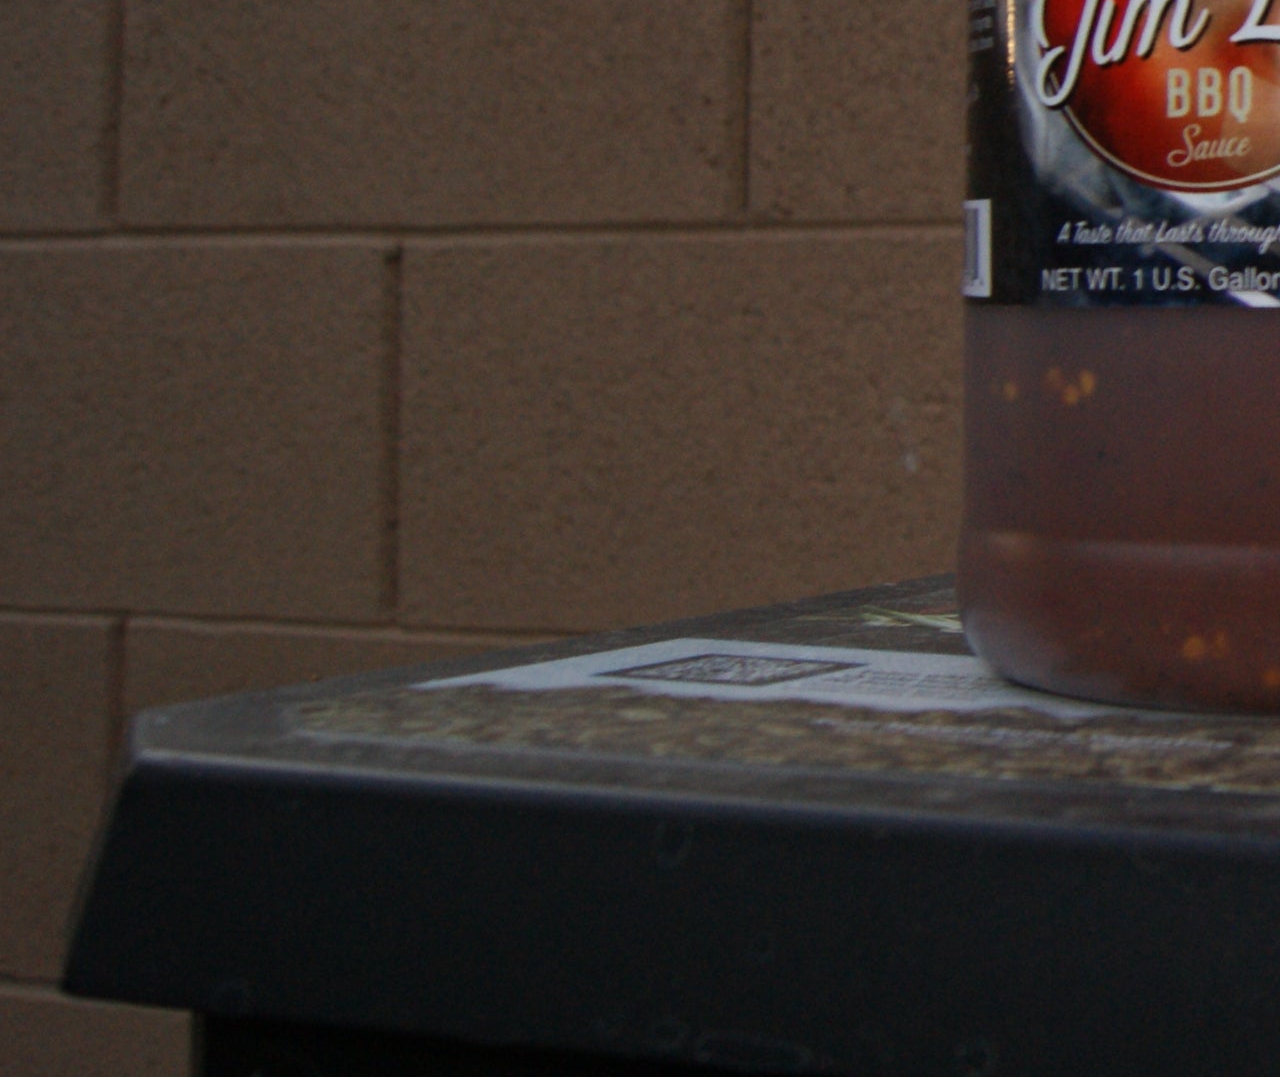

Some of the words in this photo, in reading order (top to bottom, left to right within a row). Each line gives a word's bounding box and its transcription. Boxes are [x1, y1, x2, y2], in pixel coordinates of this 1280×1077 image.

[1166, 66, 1253, 123] BBQ
[1166, 124, 1252, 167] Sauce
[1056, 220, 1072, 244] A
[1073, 220, 1113, 245] Taste
[1115, 218, 1154, 243] that
[1154, 220, 1203, 244] Lasts
[1041, 267, 1082, 291] NET
[1086, 267, 1126, 291] WT.
[1133, 267, 1144, 290] 1
[1152, 265, 1201, 291] U.S.
